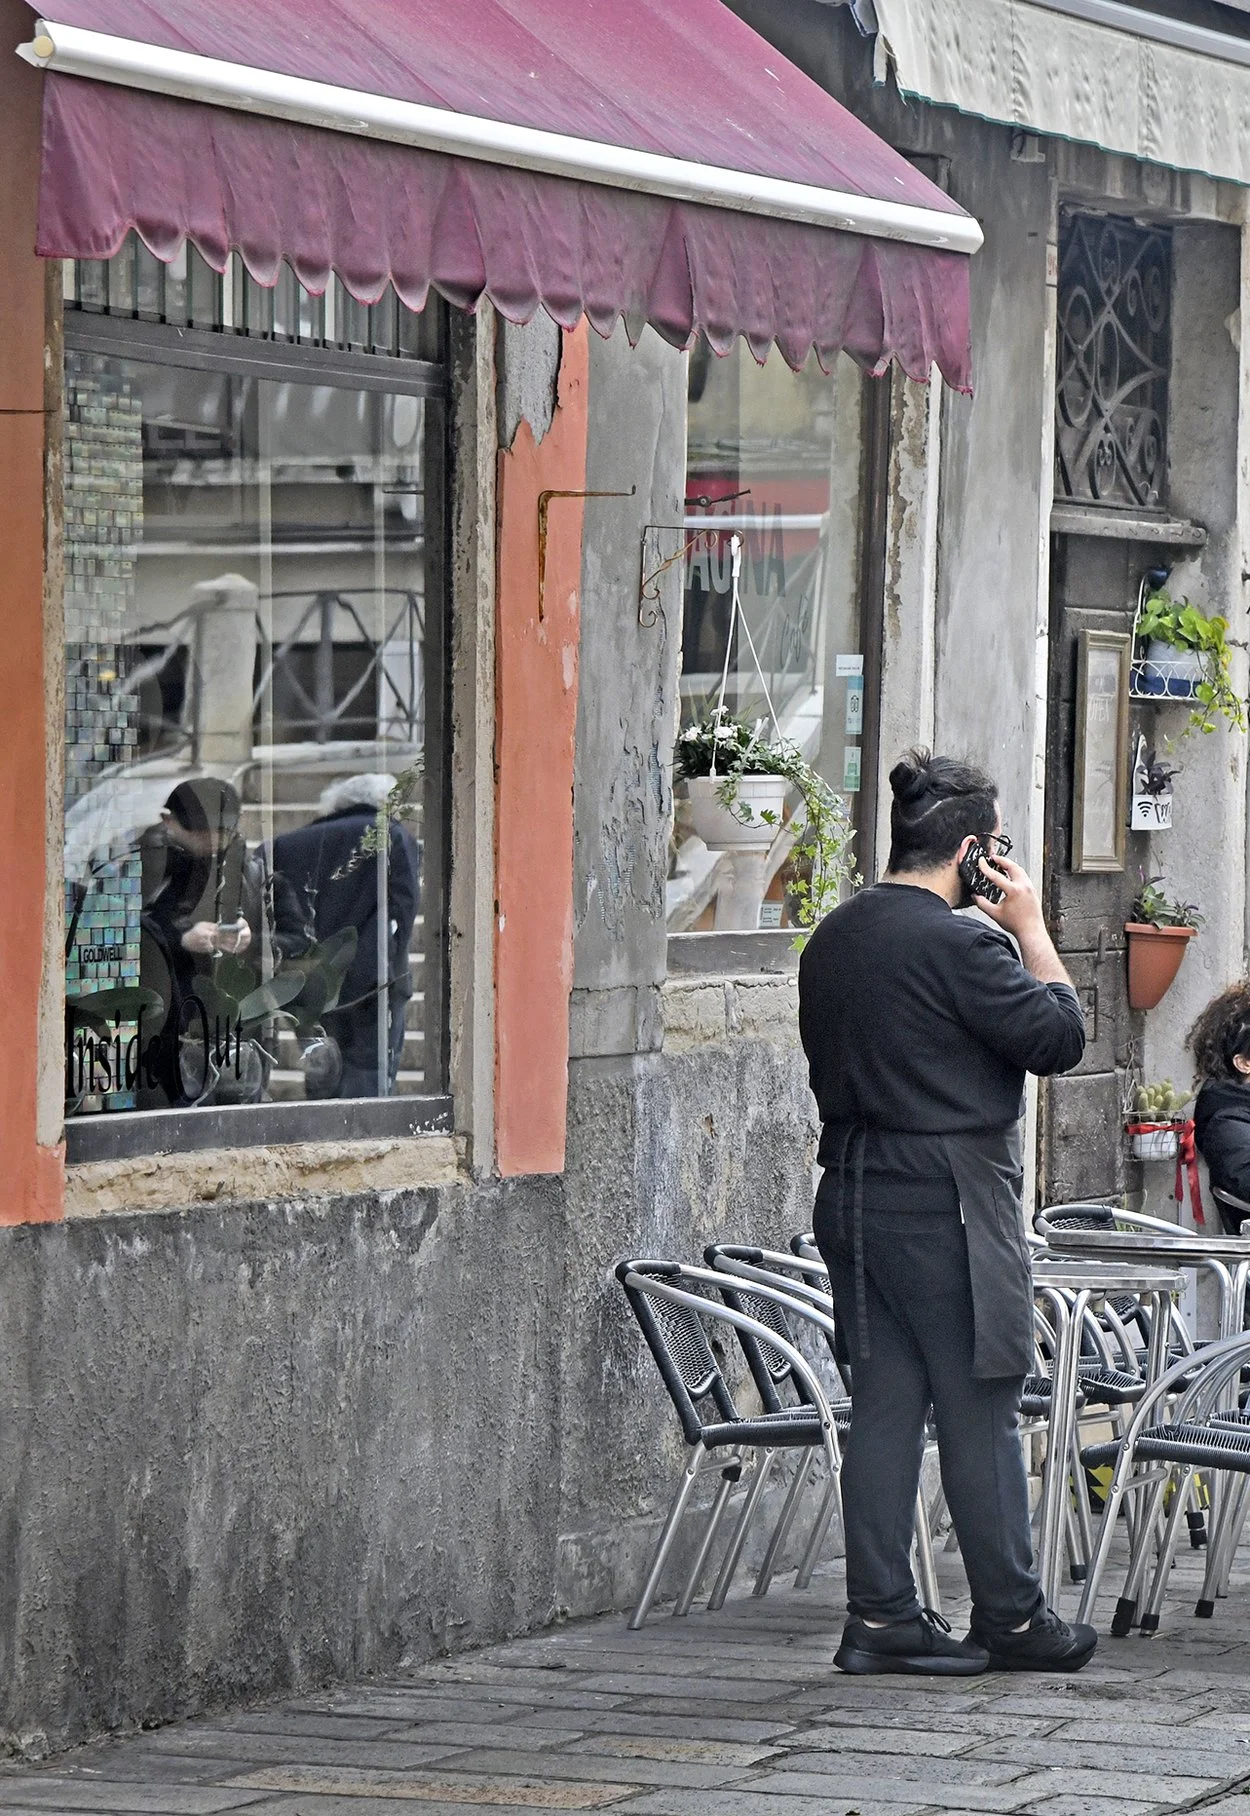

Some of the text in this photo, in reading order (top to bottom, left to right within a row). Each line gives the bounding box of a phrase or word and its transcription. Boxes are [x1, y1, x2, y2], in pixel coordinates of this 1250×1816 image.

[83, 946, 123, 963] GOLDWELL
[66, 994, 244, 1102] Inside Out
